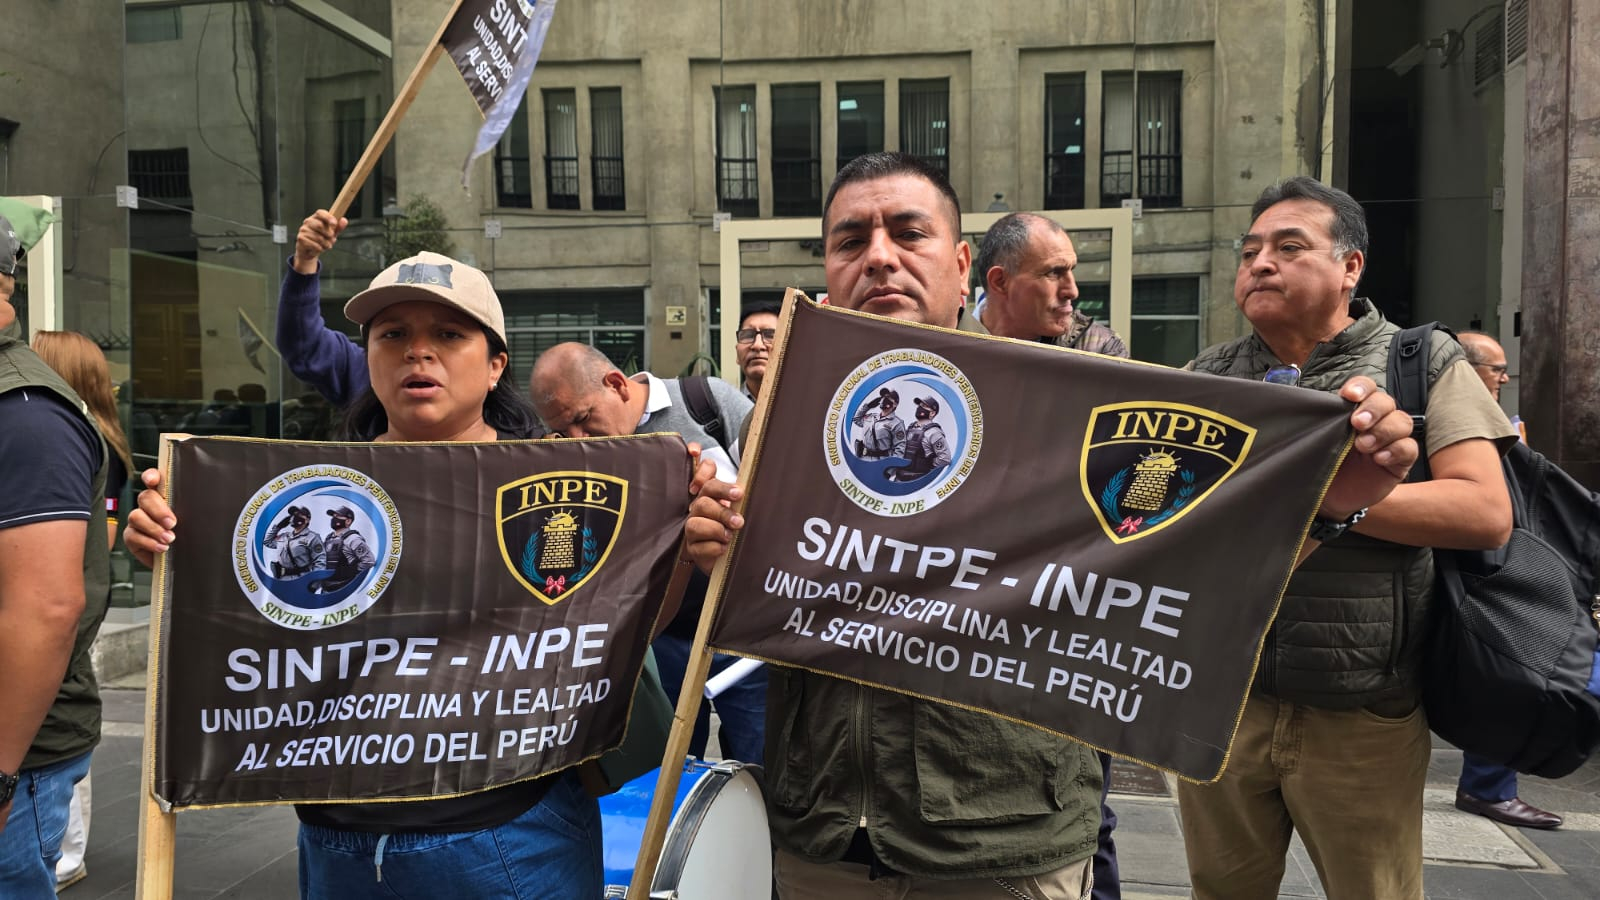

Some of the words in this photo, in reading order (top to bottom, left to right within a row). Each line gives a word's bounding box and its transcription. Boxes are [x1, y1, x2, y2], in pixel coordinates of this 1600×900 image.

[490, 0, 528, 54] SINT
[466, 46, 482, 66] AL
[868, 358, 882, 371] DE
[881, 351, 959, 379] TRABAJADORES
[834, 368, 868, 411] NACIONAL
[956, 375, 983, 459] PENITENCIARIOS
[1111, 411, 1227, 450] INPE
[827, 411, 840, 466] SINDICATO
[270, 479, 285, 493] DE
[284, 466, 366, 486] TRABAJADORES
[936, 476, 961, 498] INPE
[959, 459, 975, 477] DEL
[239, 491, 271, 538] NACIONAL
[518, 480, 608, 510] INPE
[840, 478, 883, 511] SINTPE
[889, 499, 925, 515] INPE
[236, 540, 257, 593] SINDICATO
[384, 556, 399, 575] DEL
[797, 517, 997, 591] SINTPE
[1030, 563, 1190, 638] INPE
[368, 574, 389, 598] INPE
[261, 602, 313, 628] SINTPE
[321, 603, 359, 626] INPE
[224, 637, 439, 692] SINTPE
[481, 623, 609, 674] INPE
[783, 607, 815, 637] AL
[820, 617, 960, 673] SERVICIO
[969, 652, 1036, 689] DEL
[1045, 666, 1143, 723] PERÚ
[1022, 624, 1043, 649] Y
[1047, 630, 1192, 691] LEALTAD
[471, 690, 490, 717] Y
[495, 678, 611, 716] LEALTAD
[235, 743, 269, 772] AL
[276, 733, 415, 769] SERVICIO
[424, 732, 487, 764] DEL
[497, 715, 578, 758] PERÚ
